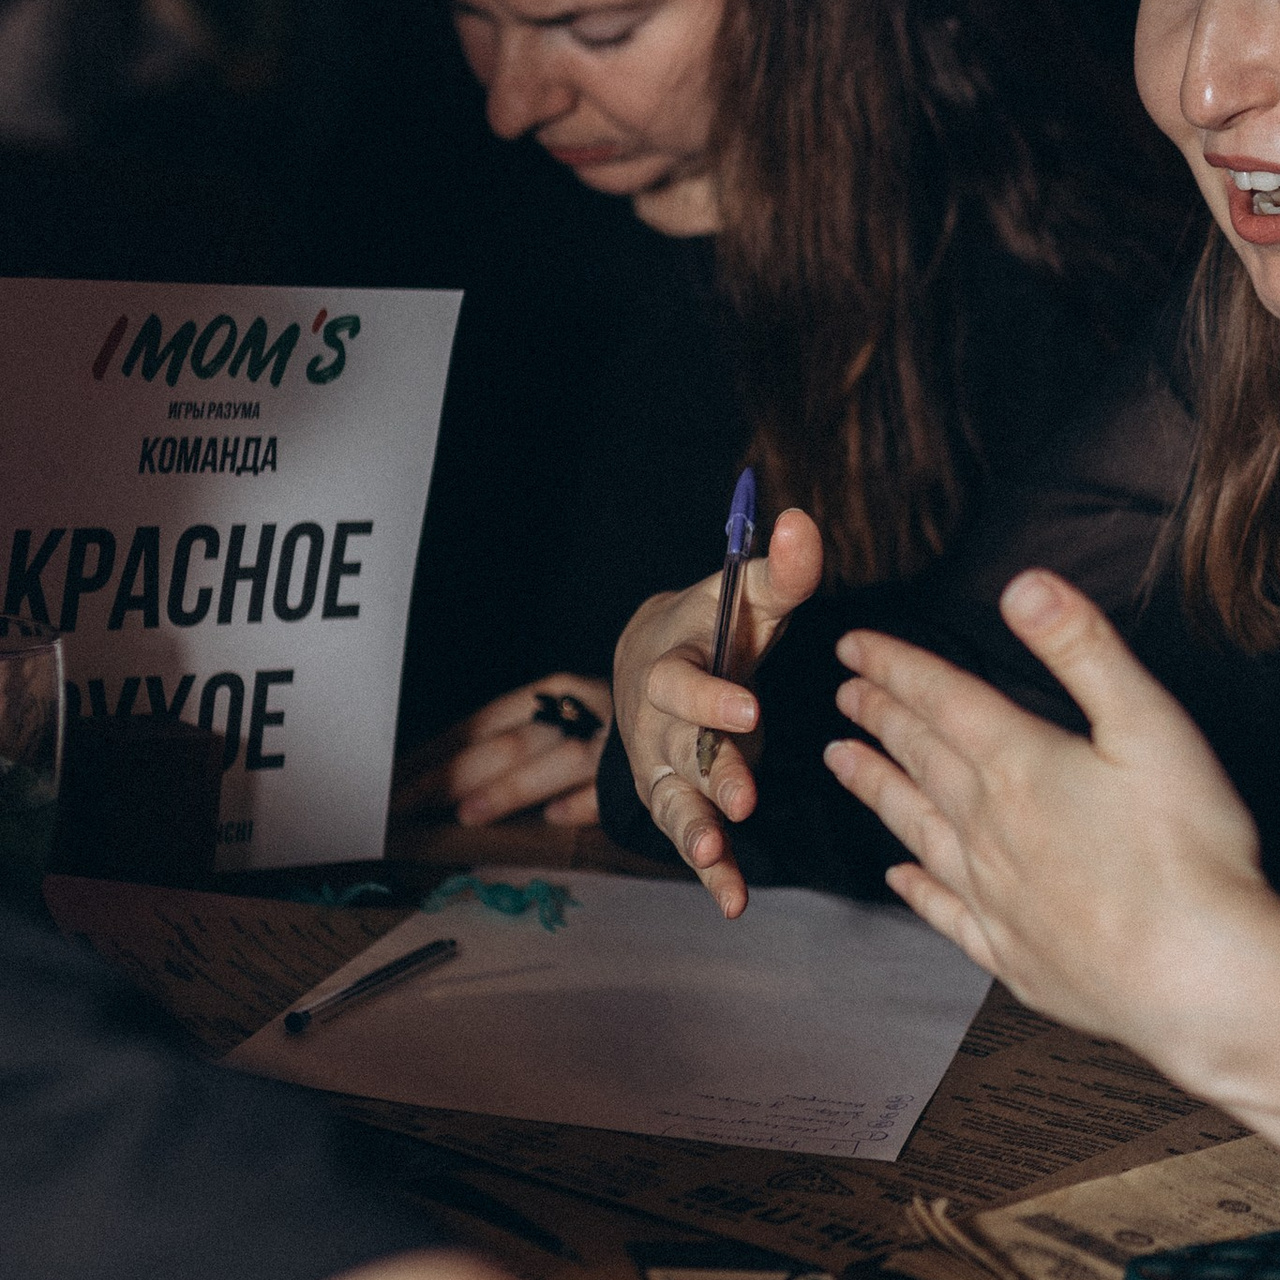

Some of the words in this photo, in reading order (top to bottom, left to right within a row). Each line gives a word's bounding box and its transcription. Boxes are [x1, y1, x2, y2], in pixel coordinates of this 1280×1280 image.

[168, 401, 205, 420] ИГРЫ
[207, 401, 260, 420] РАЗУМА
[138, 437, 278, 476] КОМАНДА
[0, 521, 373, 635] КРАСНОЕ
